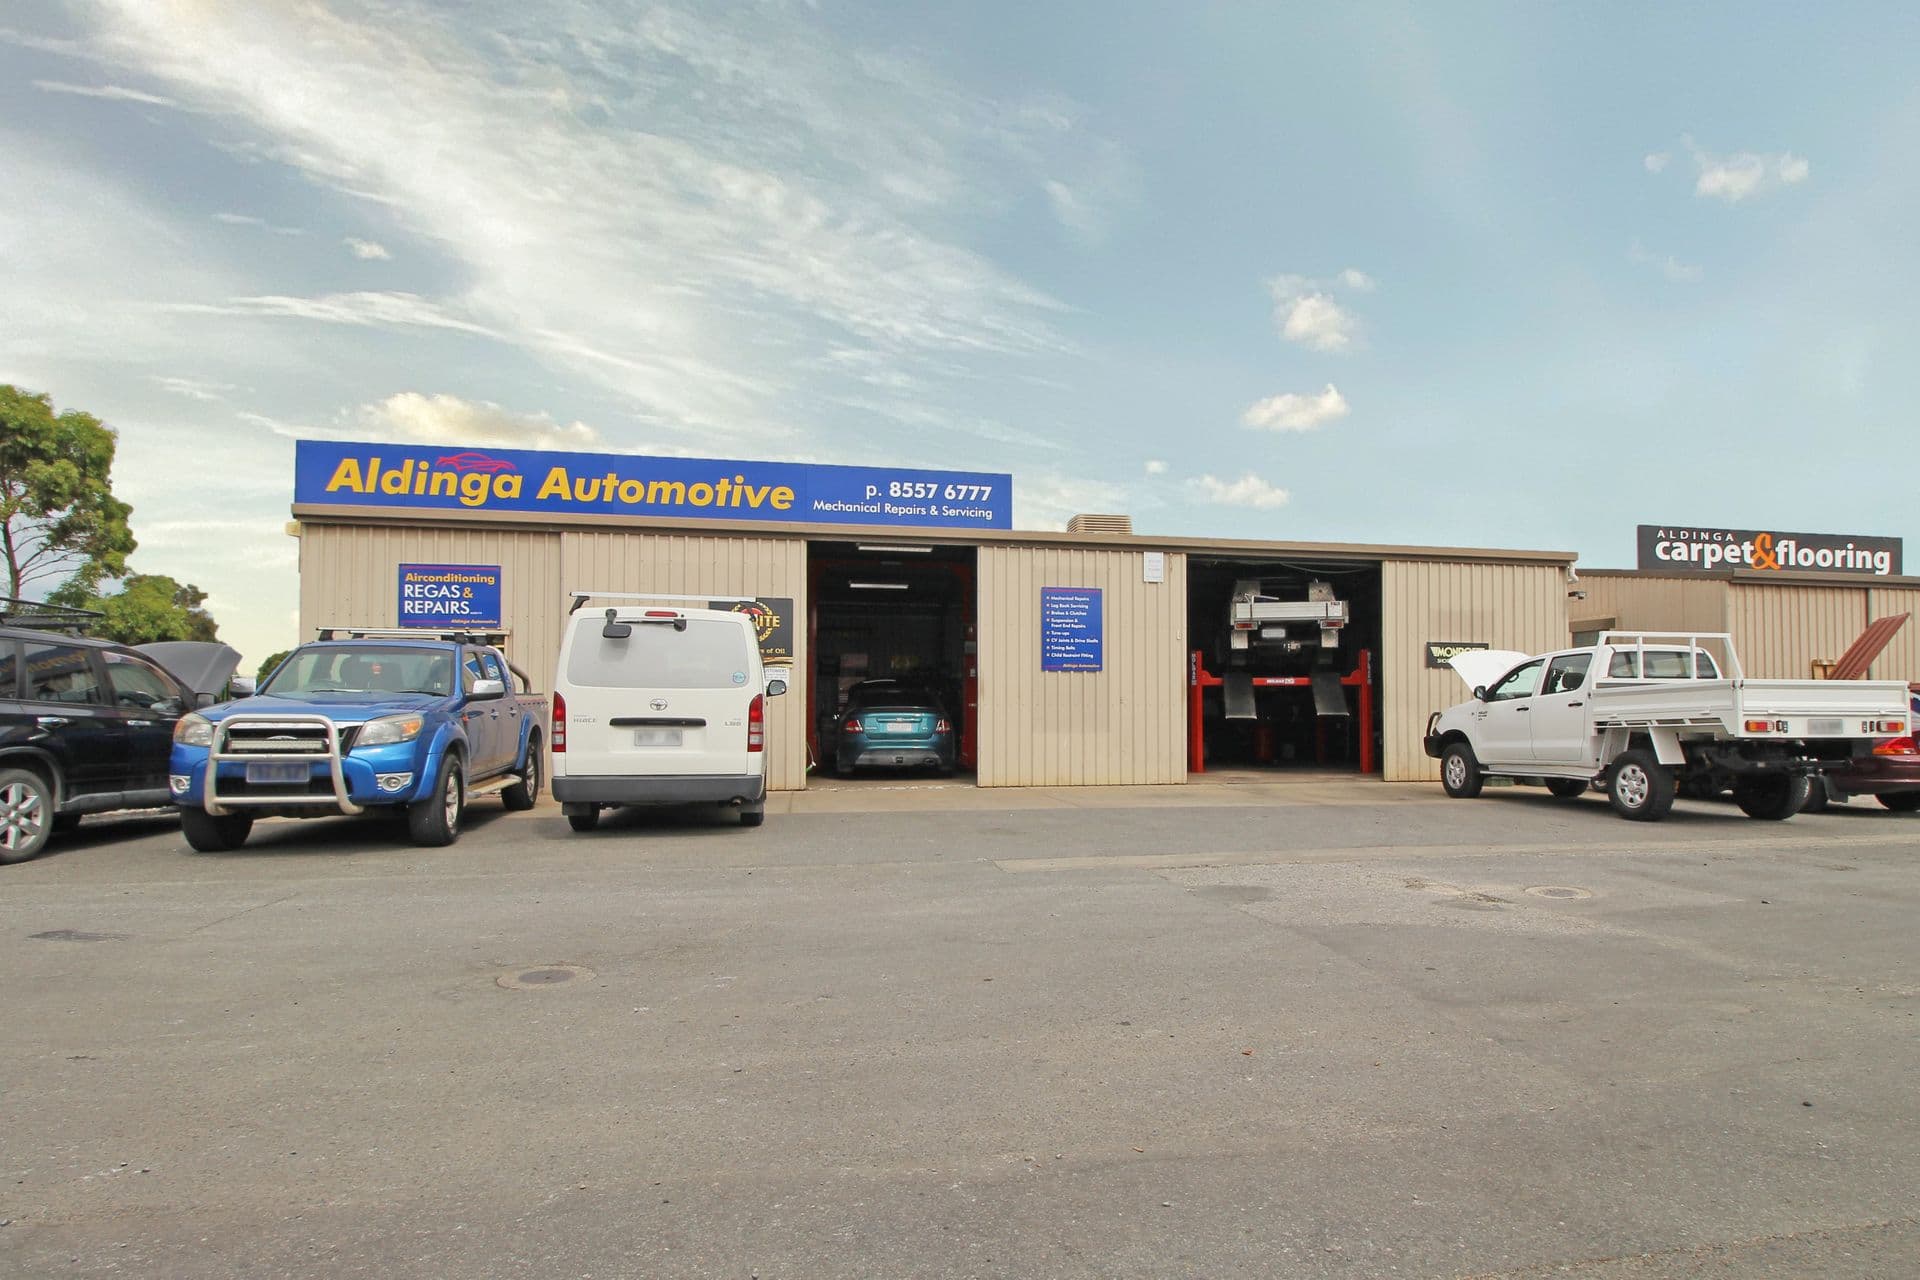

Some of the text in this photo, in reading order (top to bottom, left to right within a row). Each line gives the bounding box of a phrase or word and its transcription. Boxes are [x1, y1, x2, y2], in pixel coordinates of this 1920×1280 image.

[325, 456, 796, 511] Aldinga Automotive
[865, 481, 993, 501] p. 8557 6777
[813, 500, 993, 520] Mechanical Repairs & Servicing
[1656, 529, 1734, 542] ALDINGA
[405, 573, 495, 585] Airconditioning
[404, 584, 474, 598] REGAS &
[404, 601, 470, 614] REPAIRS
